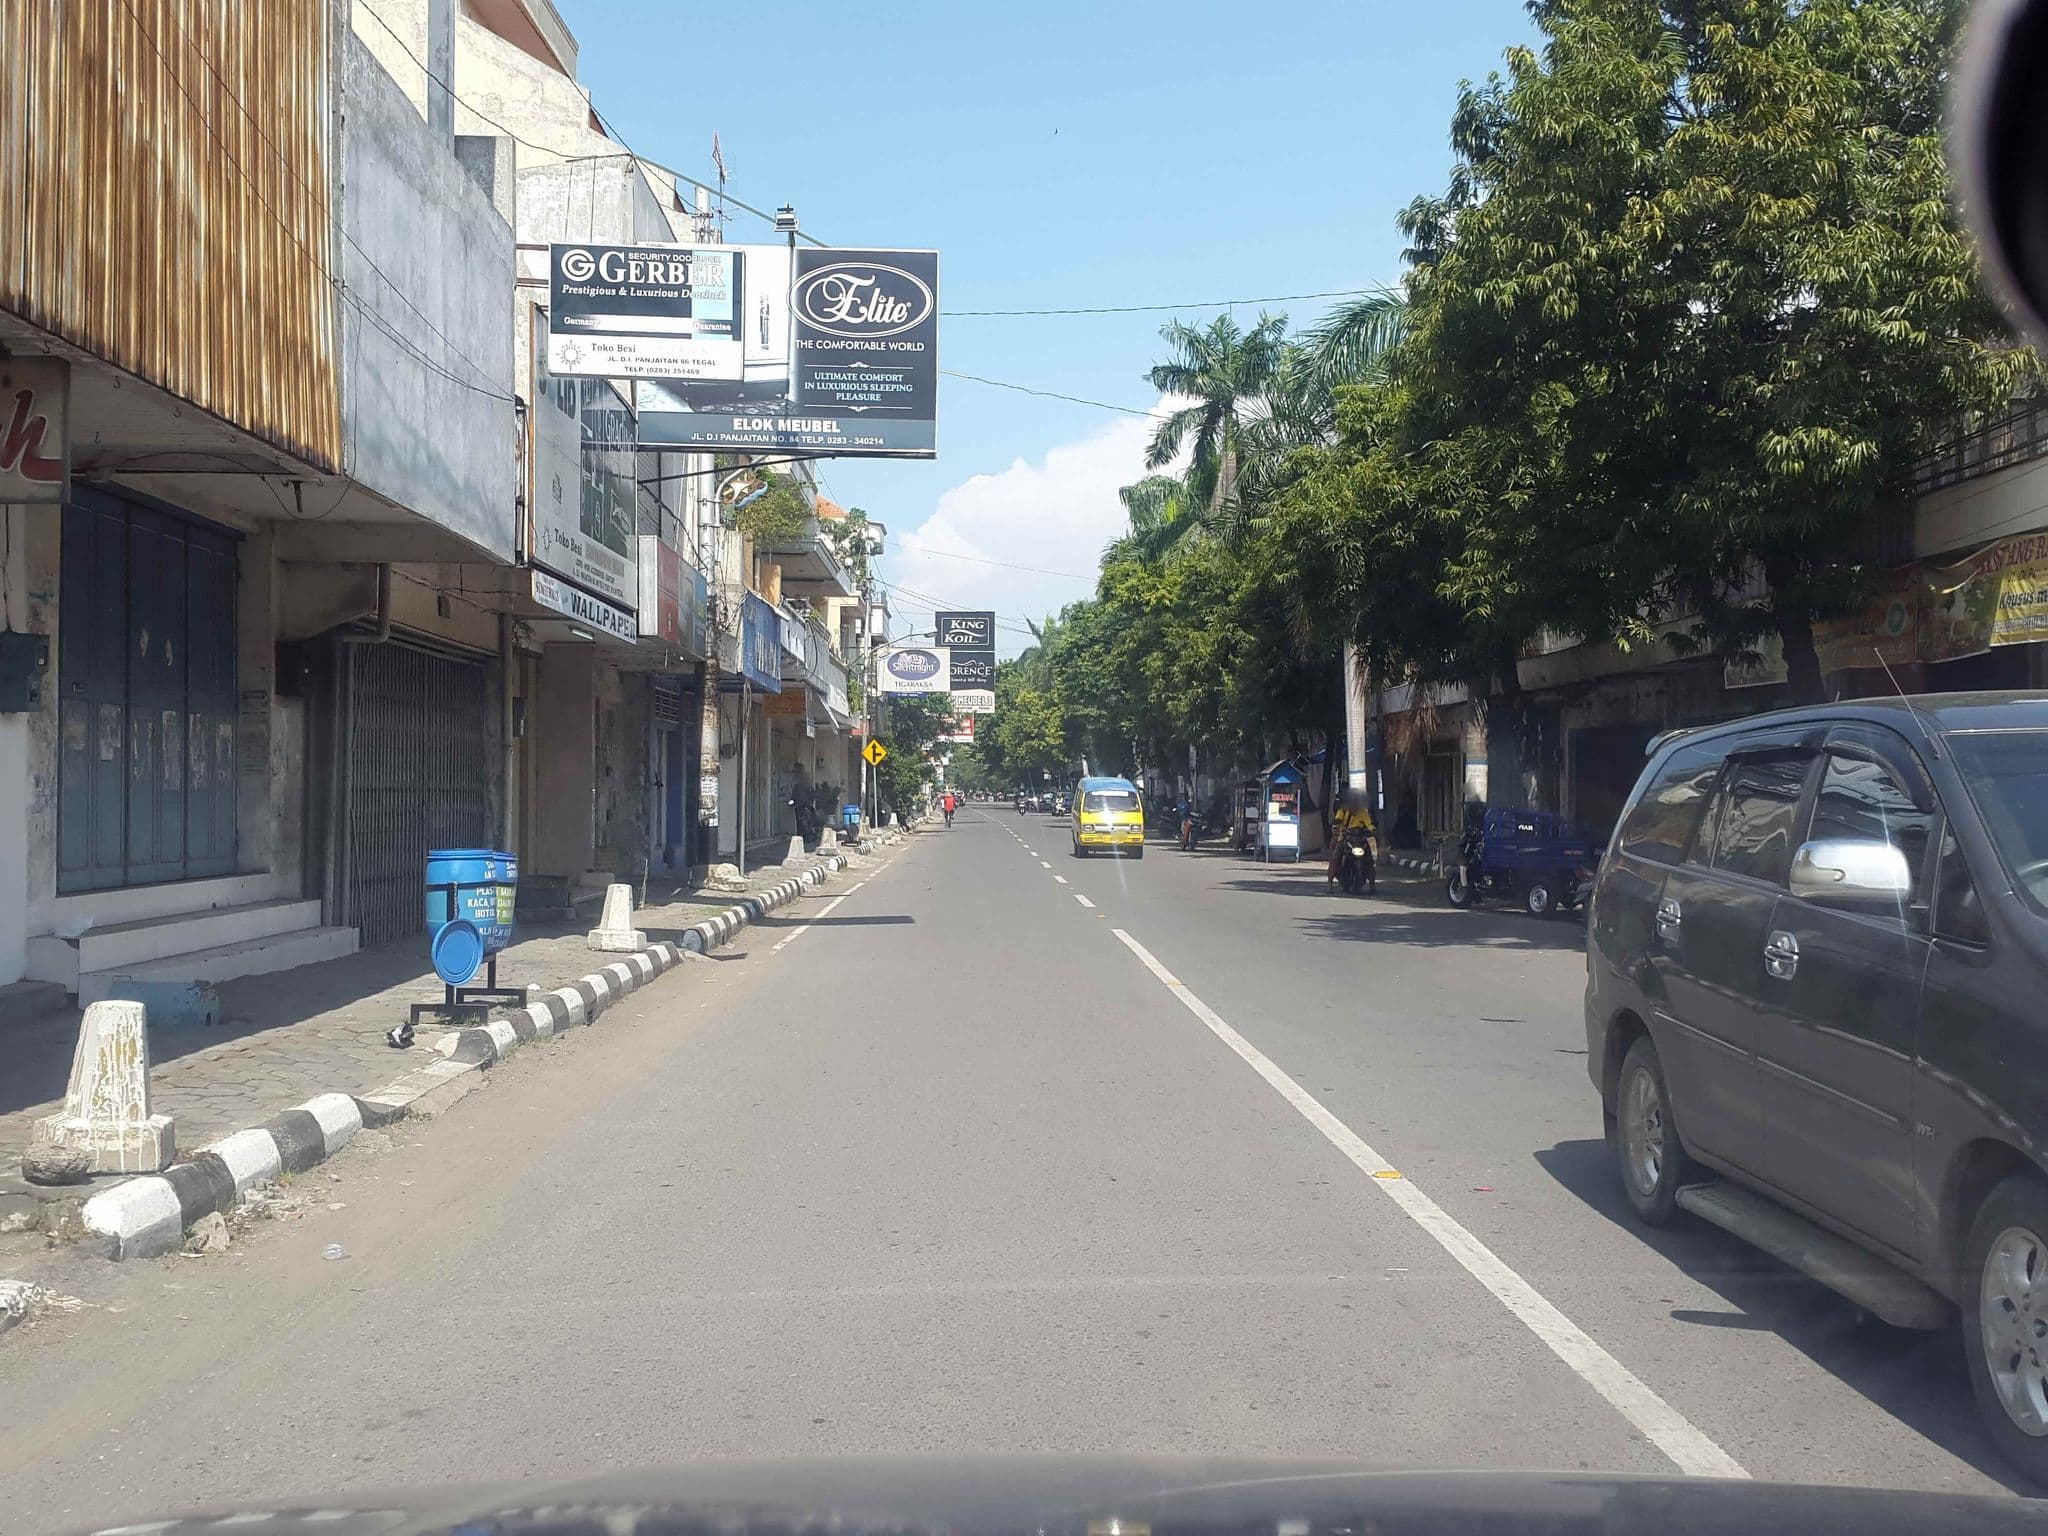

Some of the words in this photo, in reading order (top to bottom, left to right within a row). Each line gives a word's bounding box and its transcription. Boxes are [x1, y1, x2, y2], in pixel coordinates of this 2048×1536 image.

[628, 252, 671, 262] SECURITY
[598, 250, 725, 287] GERBER
[561, 284, 617, 298] Prestigious
[618, 287, 628, 297] &
[630, 286, 679, 299] Luxurious
[805, 273, 908, 324] Elite
[563, 316, 600, 329] Germany
[591, 343, 614, 352] Toko
[617, 344, 637, 353] Besi
[795, 339, 814, 349] THE
[815, 340, 887, 351] COMFORTABLE
[888, 342, 925, 351] WORLD
[635, 357, 678, 365] PANJAITAN
[814, 372, 858, 381] ULTIMATE
[859, 373, 904, 382] COMFORT
[804, 381, 815, 390] IN
[816, 382, 869, 391] LUXURIOUS
[870, 383, 914, 392] SLEEPING
[836, 392, 882, 402] PLEASURE
[733, 417, 774, 432] ELOK
[777, 418, 841, 433] MEUBEL
[691, 432, 704, 441] JL.
[720, 434, 769, 443] PANJAITAN
[770, 435, 788, 443] NO.
[801, 436, 825, 444] TELP.
[827, 436, 847, 444] 0283
[854, 437, 884, 445] 340214
[554, 528, 570, 549] Toko
[570, 537, 583, 557] Besi
[570, 592, 637, 641] WALLPAPER
[950, 619, 985, 629] KING
[944, 633, 974, 643] KOIL
